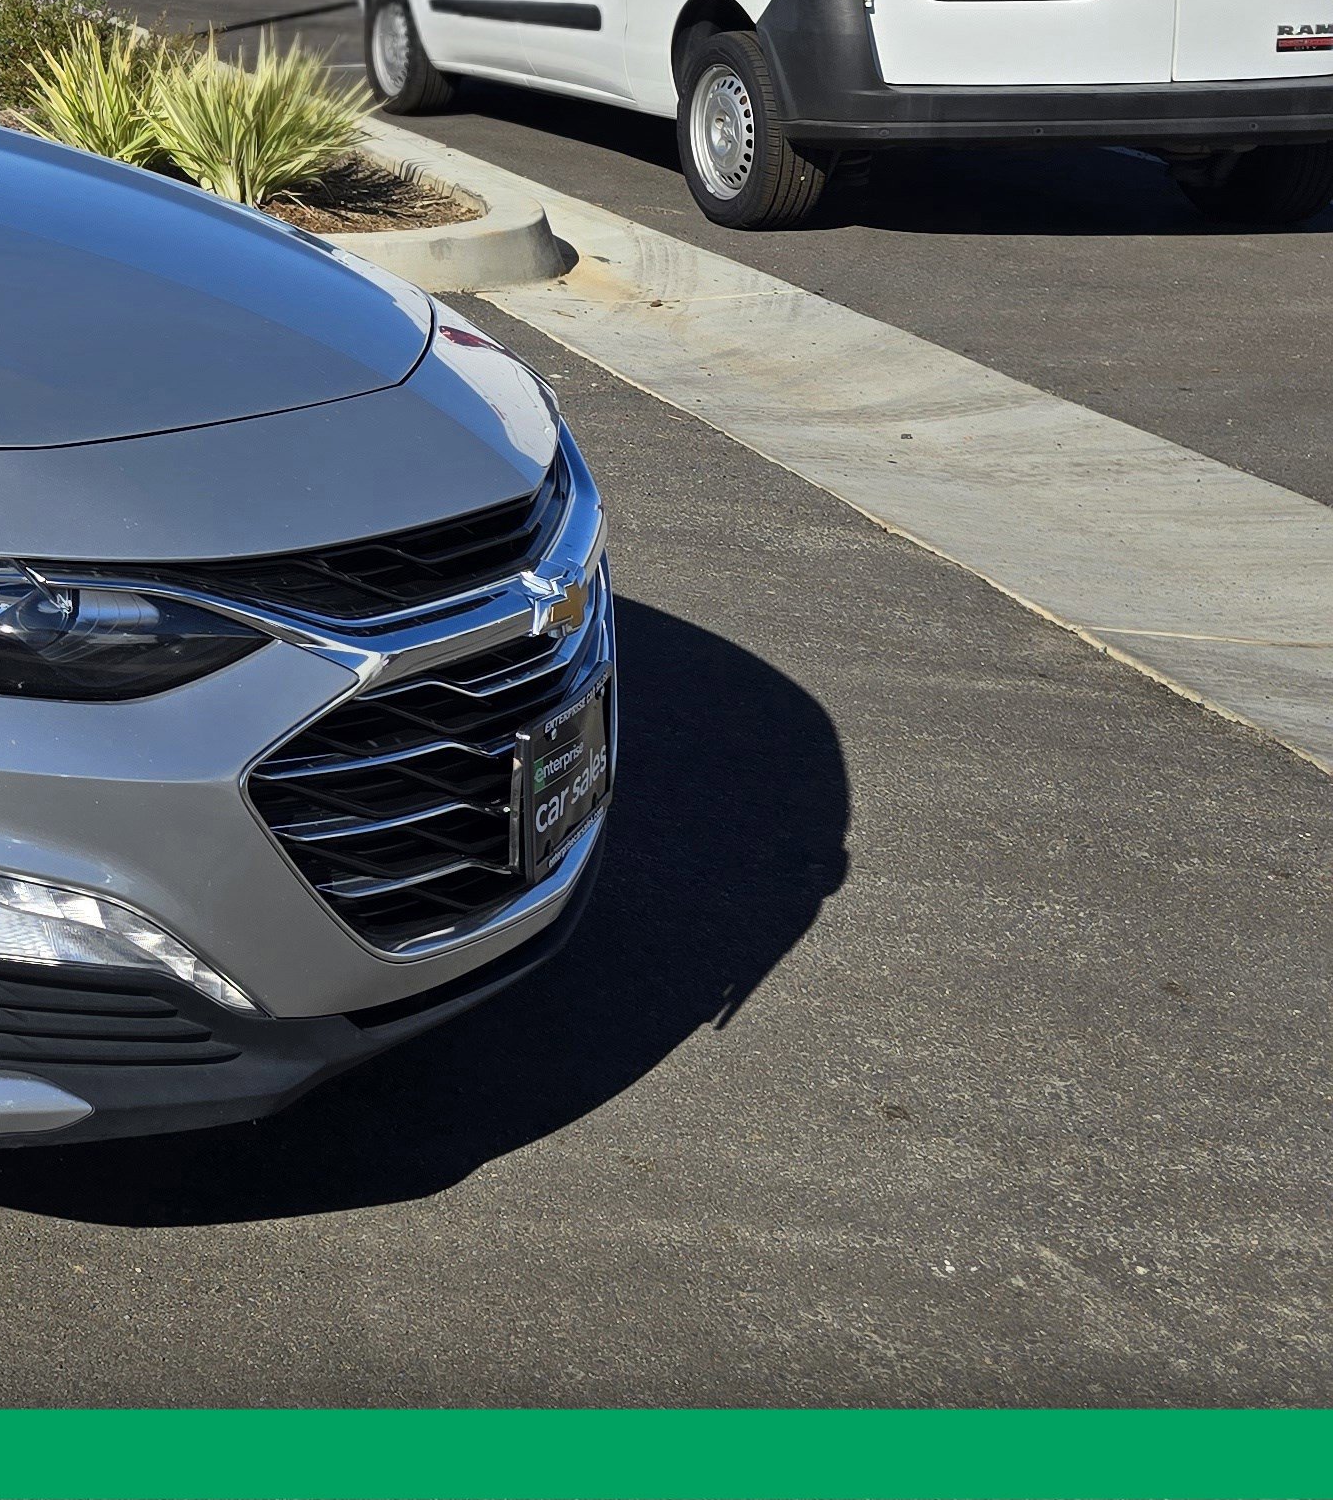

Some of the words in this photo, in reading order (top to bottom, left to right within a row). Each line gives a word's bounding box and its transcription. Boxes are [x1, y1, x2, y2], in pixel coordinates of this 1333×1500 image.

[1277, 23, 1333, 35] RAM
[544, 696, 587, 734] ENTERPRISE
[534, 741, 584, 784] enterprise
[535, 786, 569, 833] car
[571, 744, 607, 805] sales
